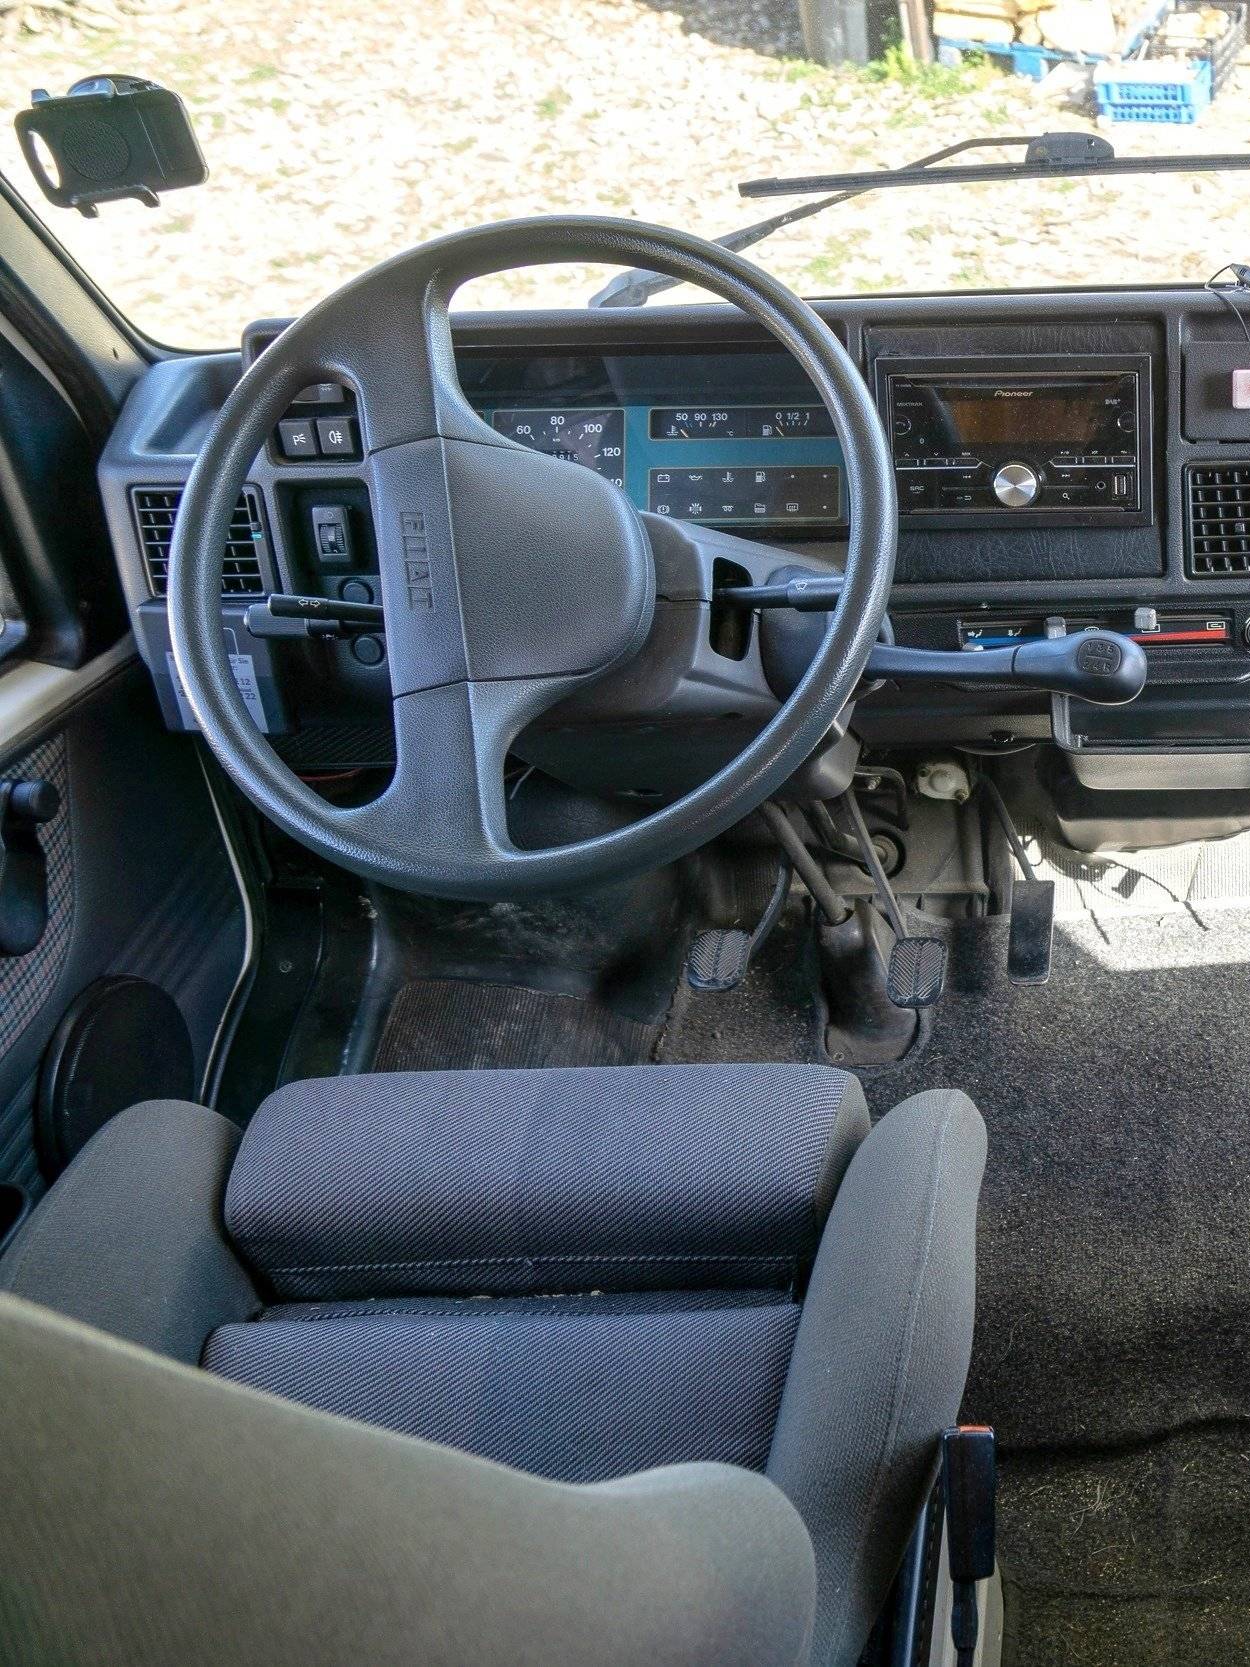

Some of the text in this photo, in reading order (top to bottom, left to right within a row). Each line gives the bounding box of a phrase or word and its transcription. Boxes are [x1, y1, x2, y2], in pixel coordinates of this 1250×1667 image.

[550, 415, 565, 425] 80
[675, 413, 728, 421] 50 90 130
[787, 412, 800, 420] 1/2
[805, 412, 810, 420] 1
[516, 425, 531, 435] 60
[583, 423, 603, 433] 100
[602, 447, 621, 457] 120
[400, 511, 436, 613] FIAT
[1107, 645, 1114, 653] 5
